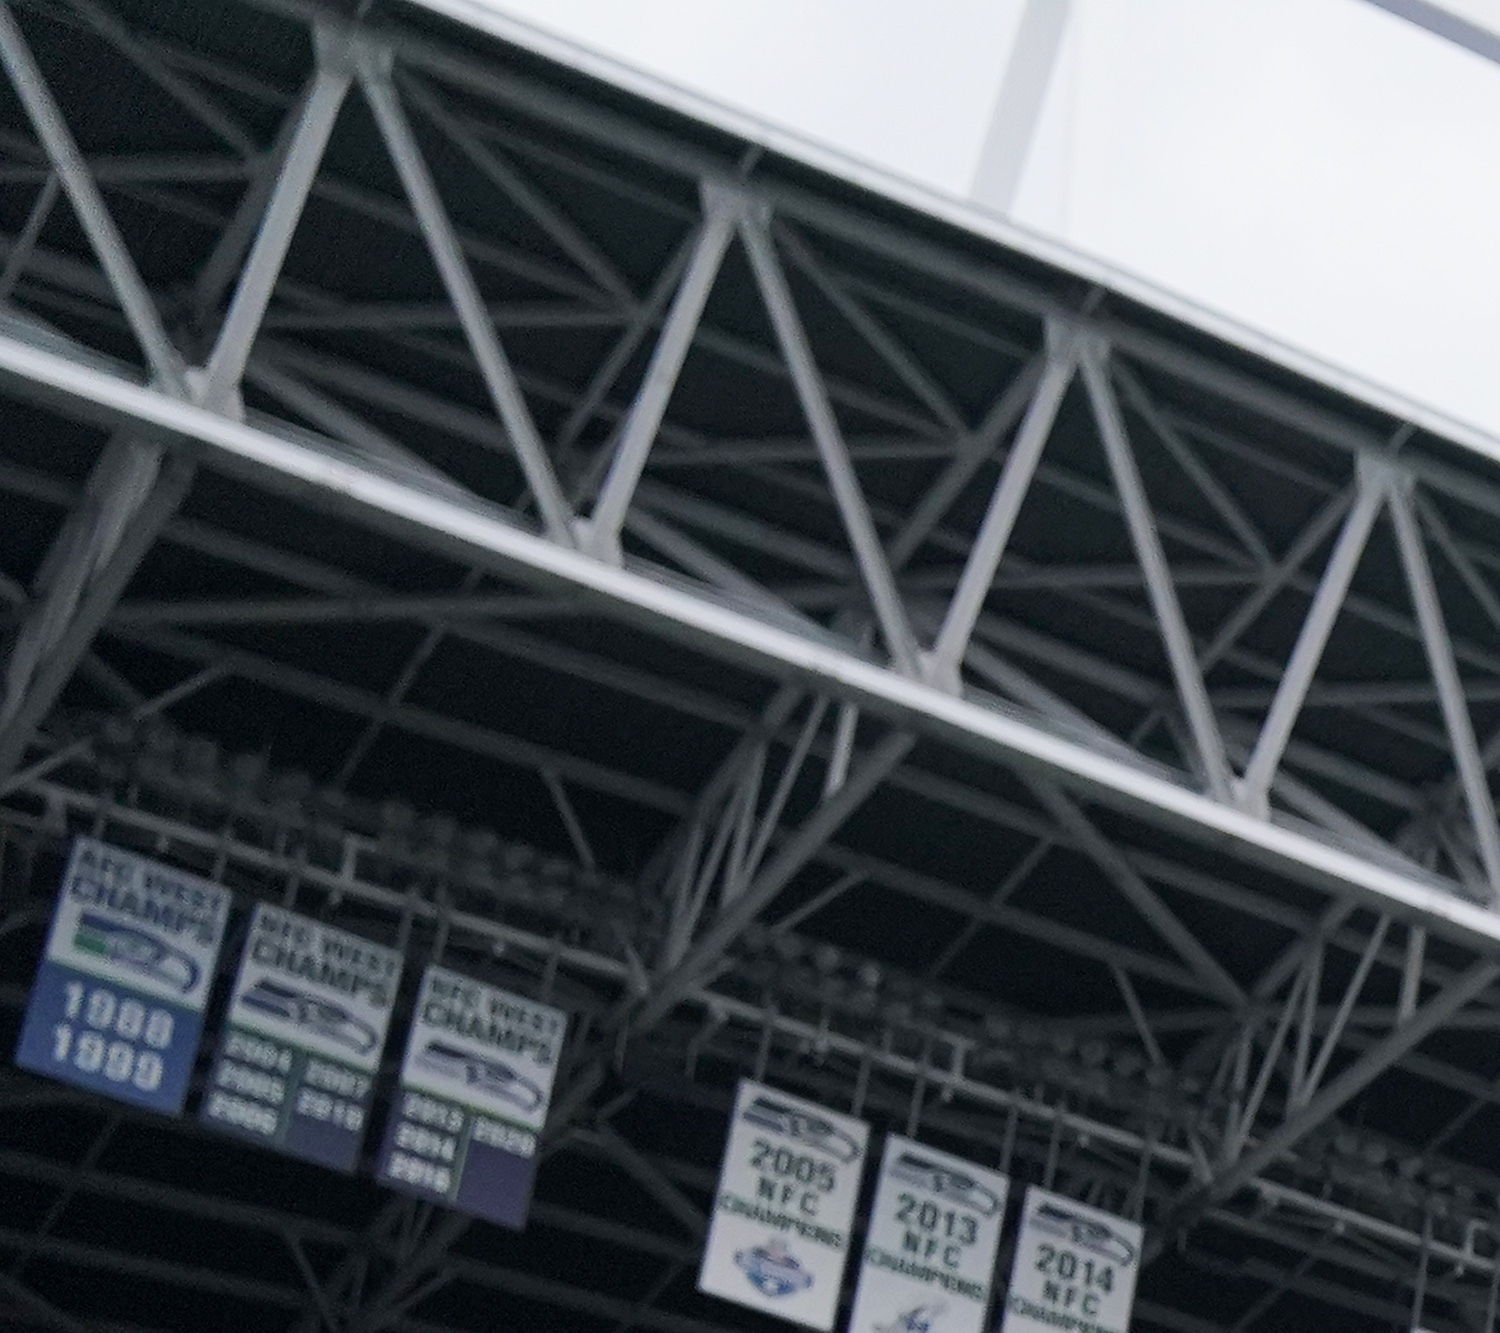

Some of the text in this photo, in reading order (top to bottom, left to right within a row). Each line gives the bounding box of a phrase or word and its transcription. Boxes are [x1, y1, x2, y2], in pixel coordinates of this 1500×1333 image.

[251, 936, 389, 1007] CHAMPS
[422, 1002, 552, 1067] CHAMPS
[751, 1138, 837, 1193] 2005
[757, 1175, 820, 1217] NFC
[895, 1191, 978, 1246] 2013
[902, 1229, 963, 1271] NFC
[1034, 1243, 1114, 1296] 2014
[1041, 1279, 1100, 1318] NFC
